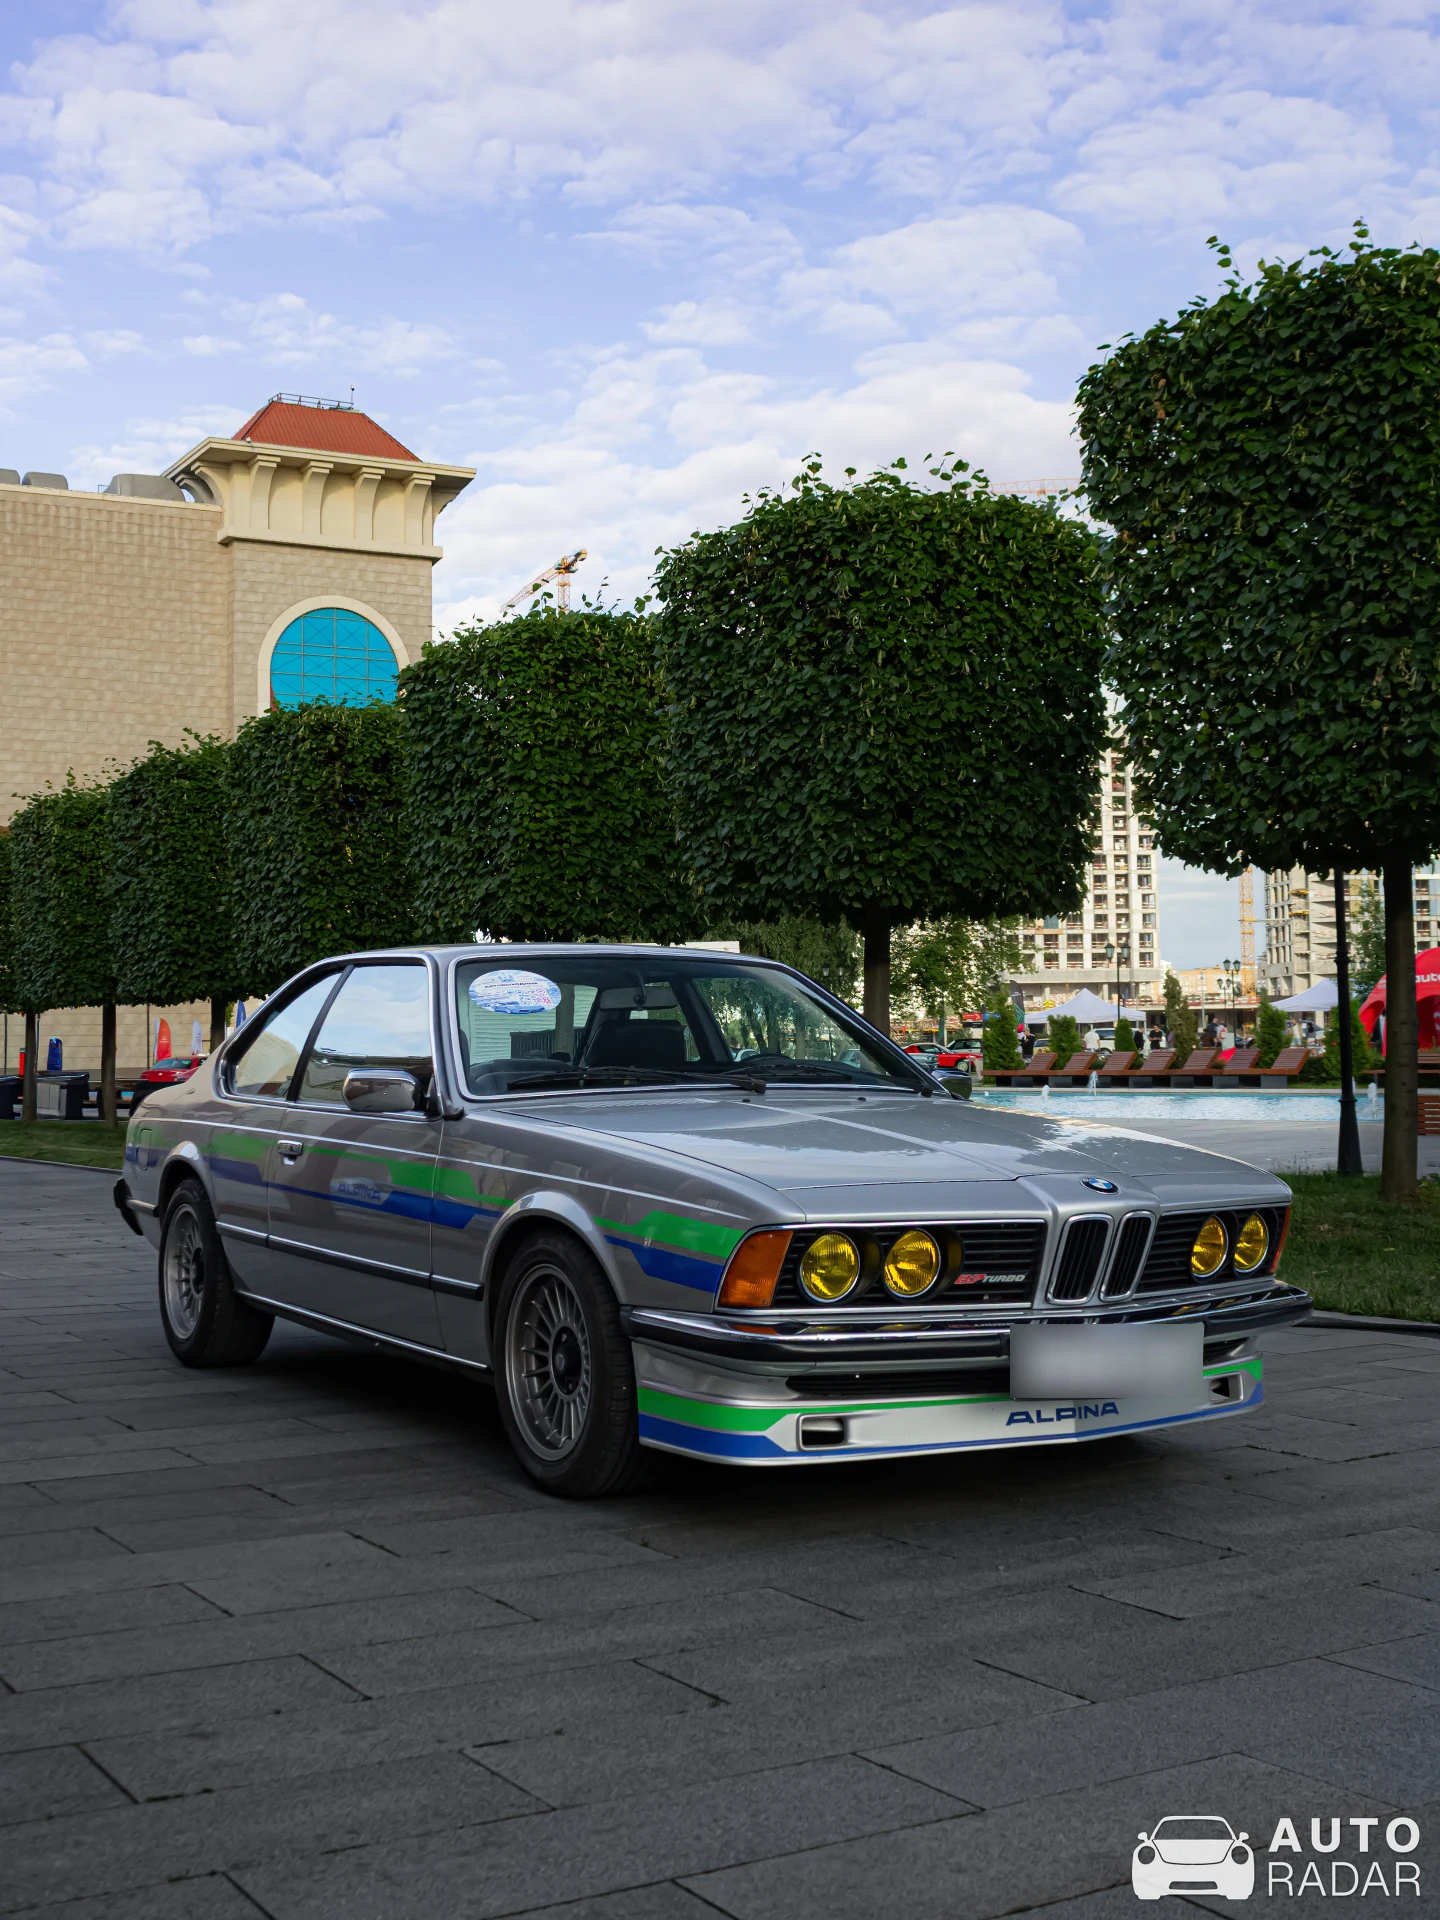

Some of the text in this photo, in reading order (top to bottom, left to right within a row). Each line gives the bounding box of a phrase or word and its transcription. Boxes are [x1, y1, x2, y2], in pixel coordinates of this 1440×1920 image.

[1415, 972, 1440, 983] aut
[337, 1183, 381, 1200] ALPINA
[981, 1274, 1026, 1283] TURBO
[1005, 1401, 1120, 1426] ALPINA
